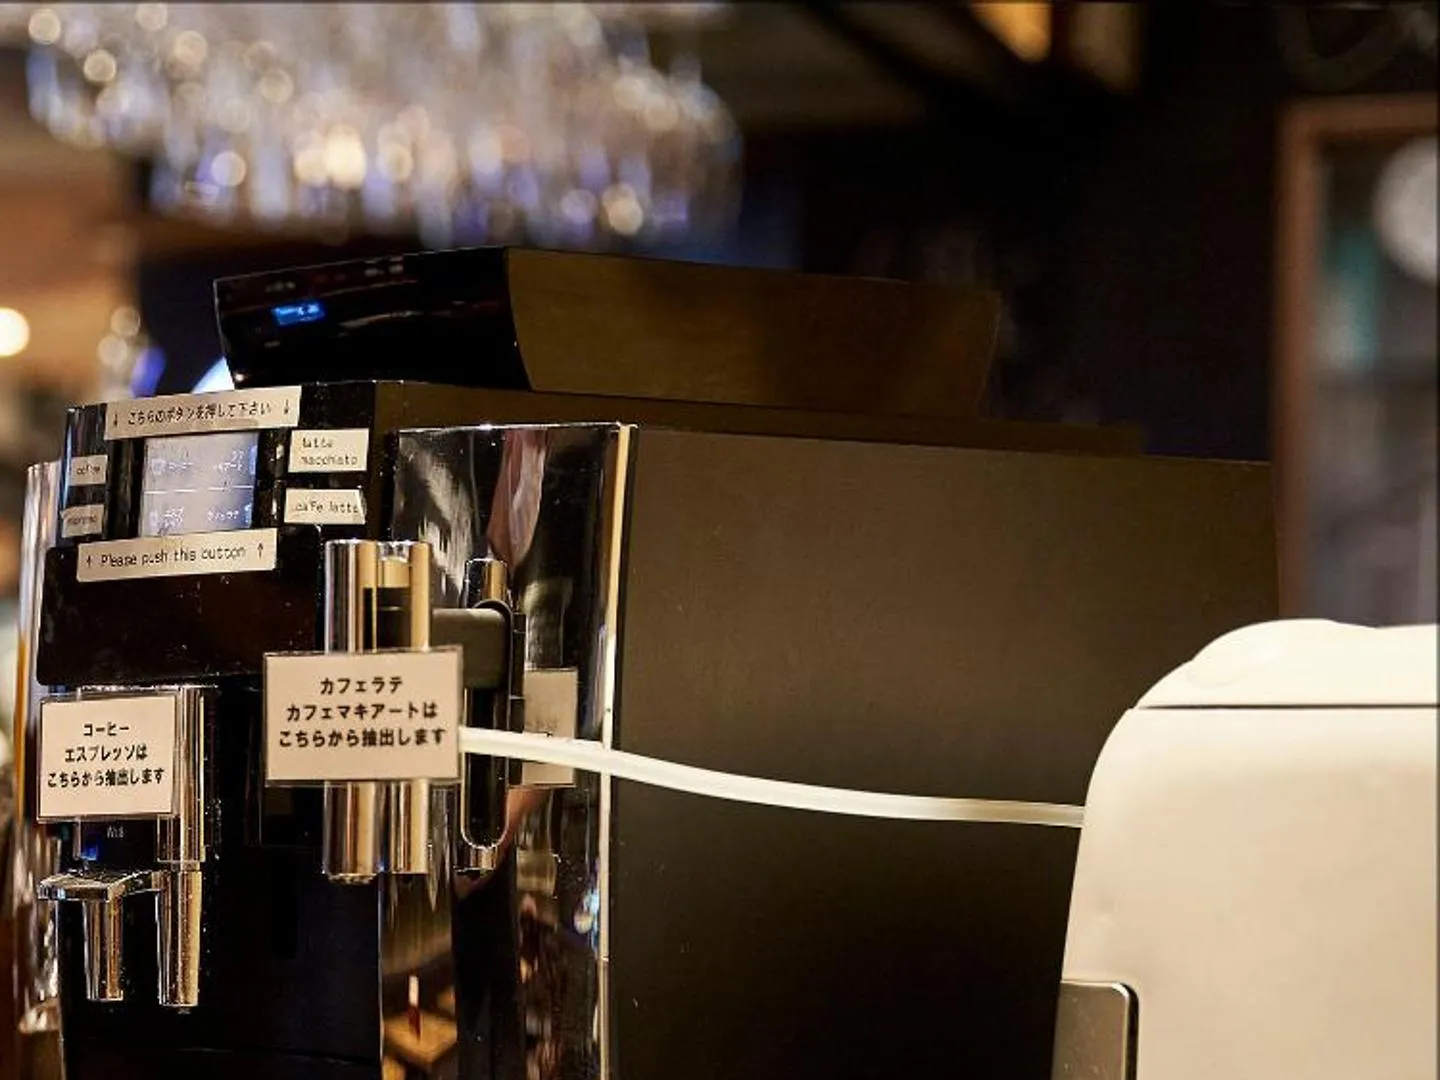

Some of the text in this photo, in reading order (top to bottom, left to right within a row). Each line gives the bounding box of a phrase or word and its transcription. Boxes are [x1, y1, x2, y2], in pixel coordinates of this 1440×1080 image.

[100, 553, 137, 568] Please
[173, 548, 196, 562] this
[320, 676, 403, 696] カフェラテ
[287, 702, 438, 722] カフェマキアートは
[83, 722, 130, 737] コーヒー
[279, 728, 446, 748] こちらから抽出します
[65, 743, 148, 763] エスプレッソは
[47, 767, 165, 788] こちらから抽出します
